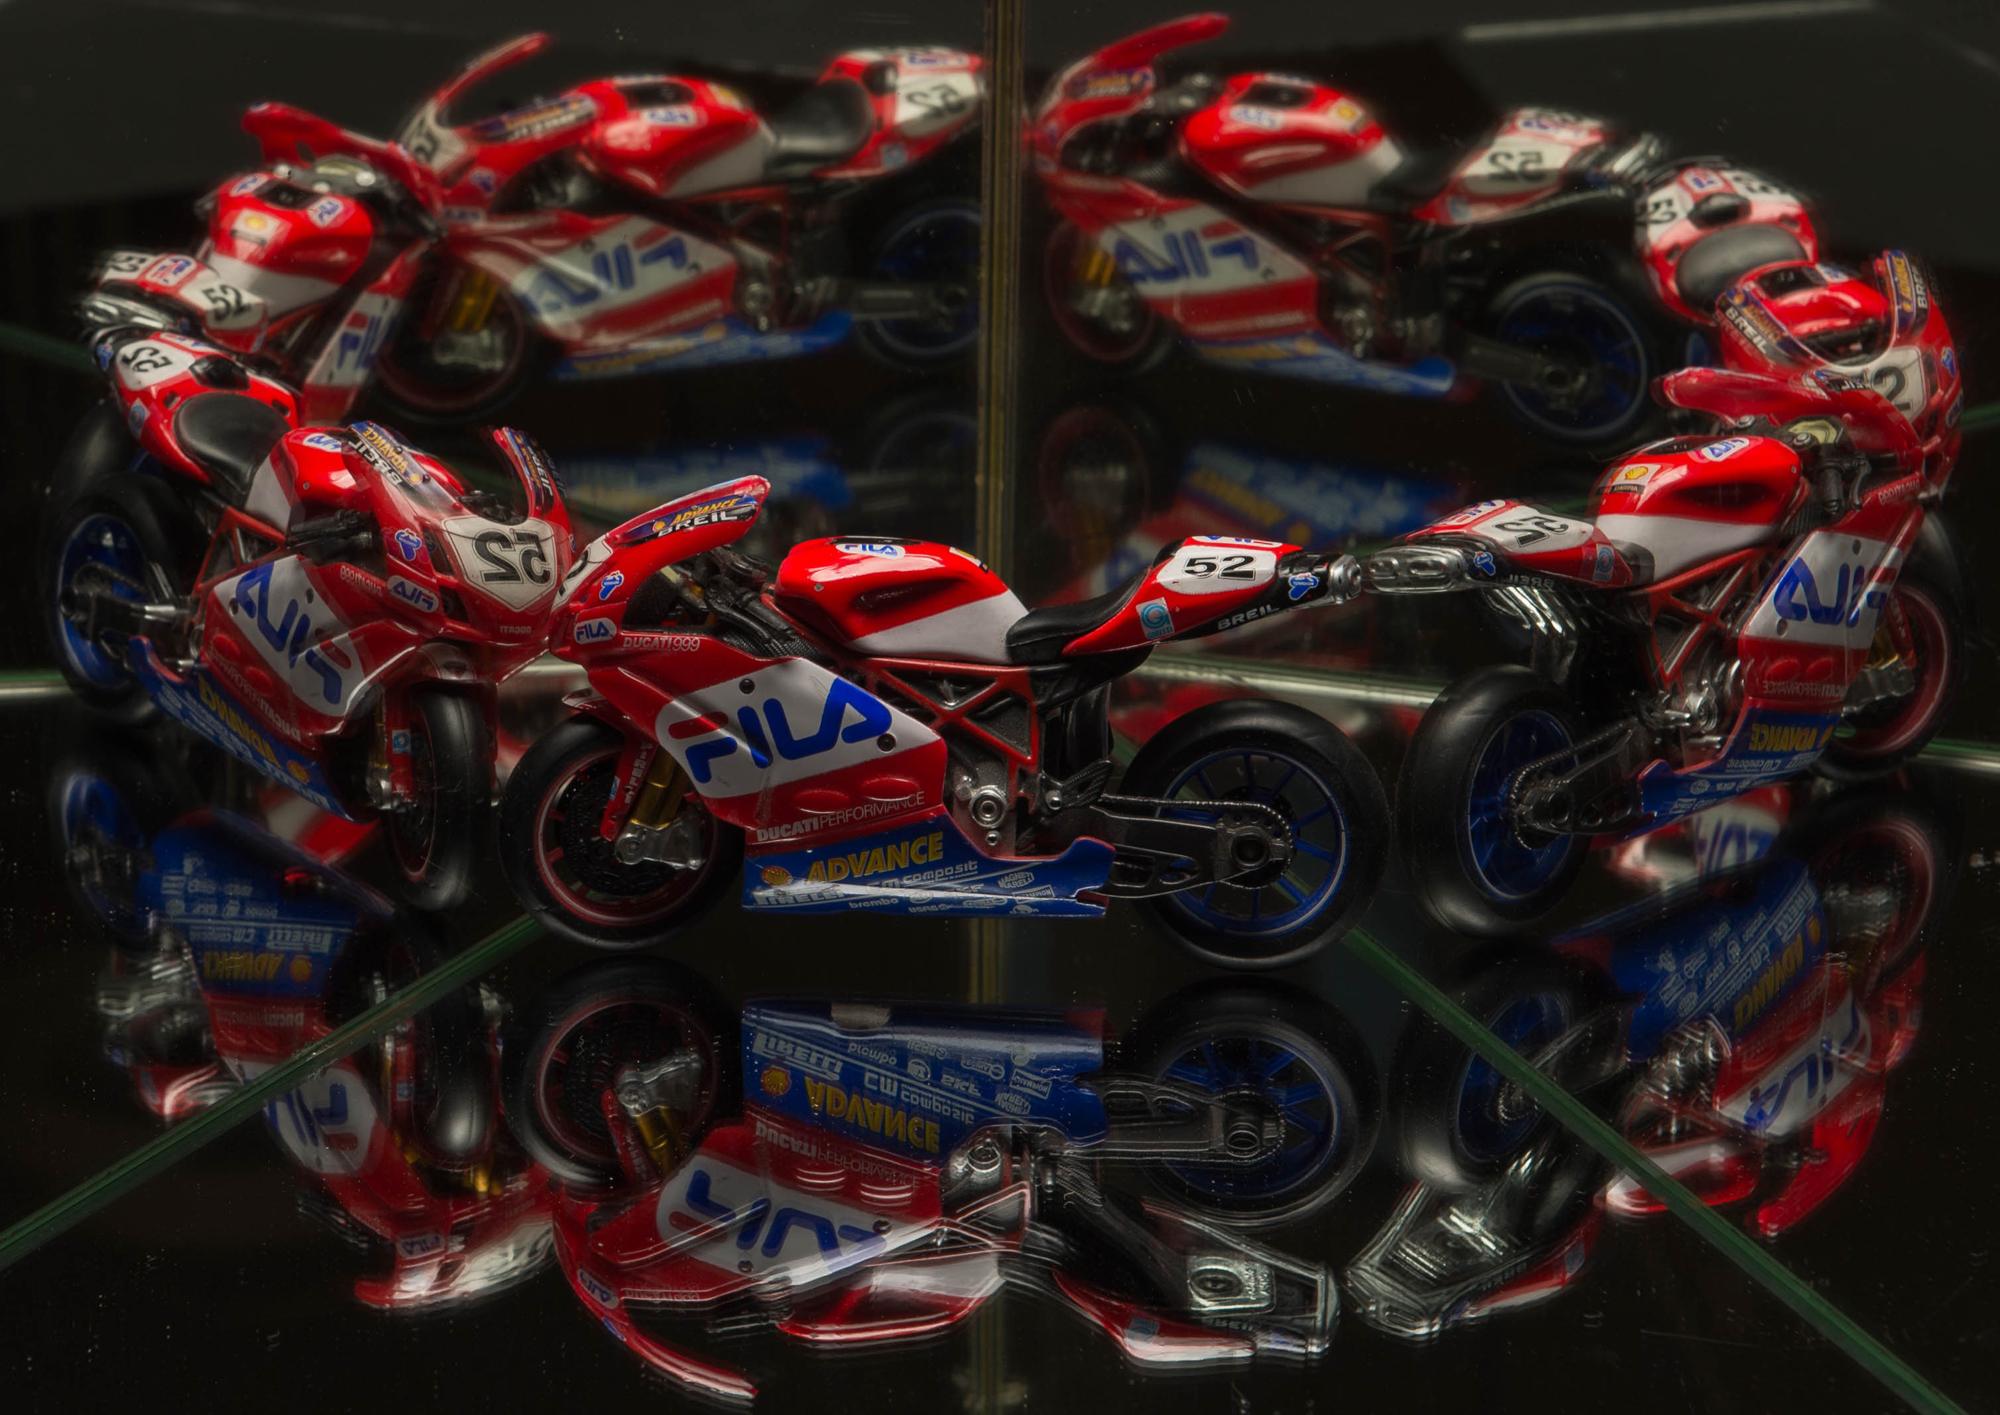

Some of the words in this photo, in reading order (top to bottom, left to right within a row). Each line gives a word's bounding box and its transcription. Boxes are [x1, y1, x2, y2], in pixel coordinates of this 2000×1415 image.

[202, 285, 244, 321] 52
[1725, 308, 1768, 354] BREIL
[1871, 366, 1912, 412] 2
[671, 497, 739, 524] ADVANCE
[658, 511, 738, 537] BREIL
[844, 543, 898, 557] FILA
[1184, 555, 1256, 581] 52
[1217, 605, 1279, 630] BREIL
[576, 621, 611, 641] FILA
[668, 677, 892, 783] FILA
[806, 832, 944, 883] ADVANCE
[902, 860, 978, 884] composit
[849, 897, 899, 909] brembo
